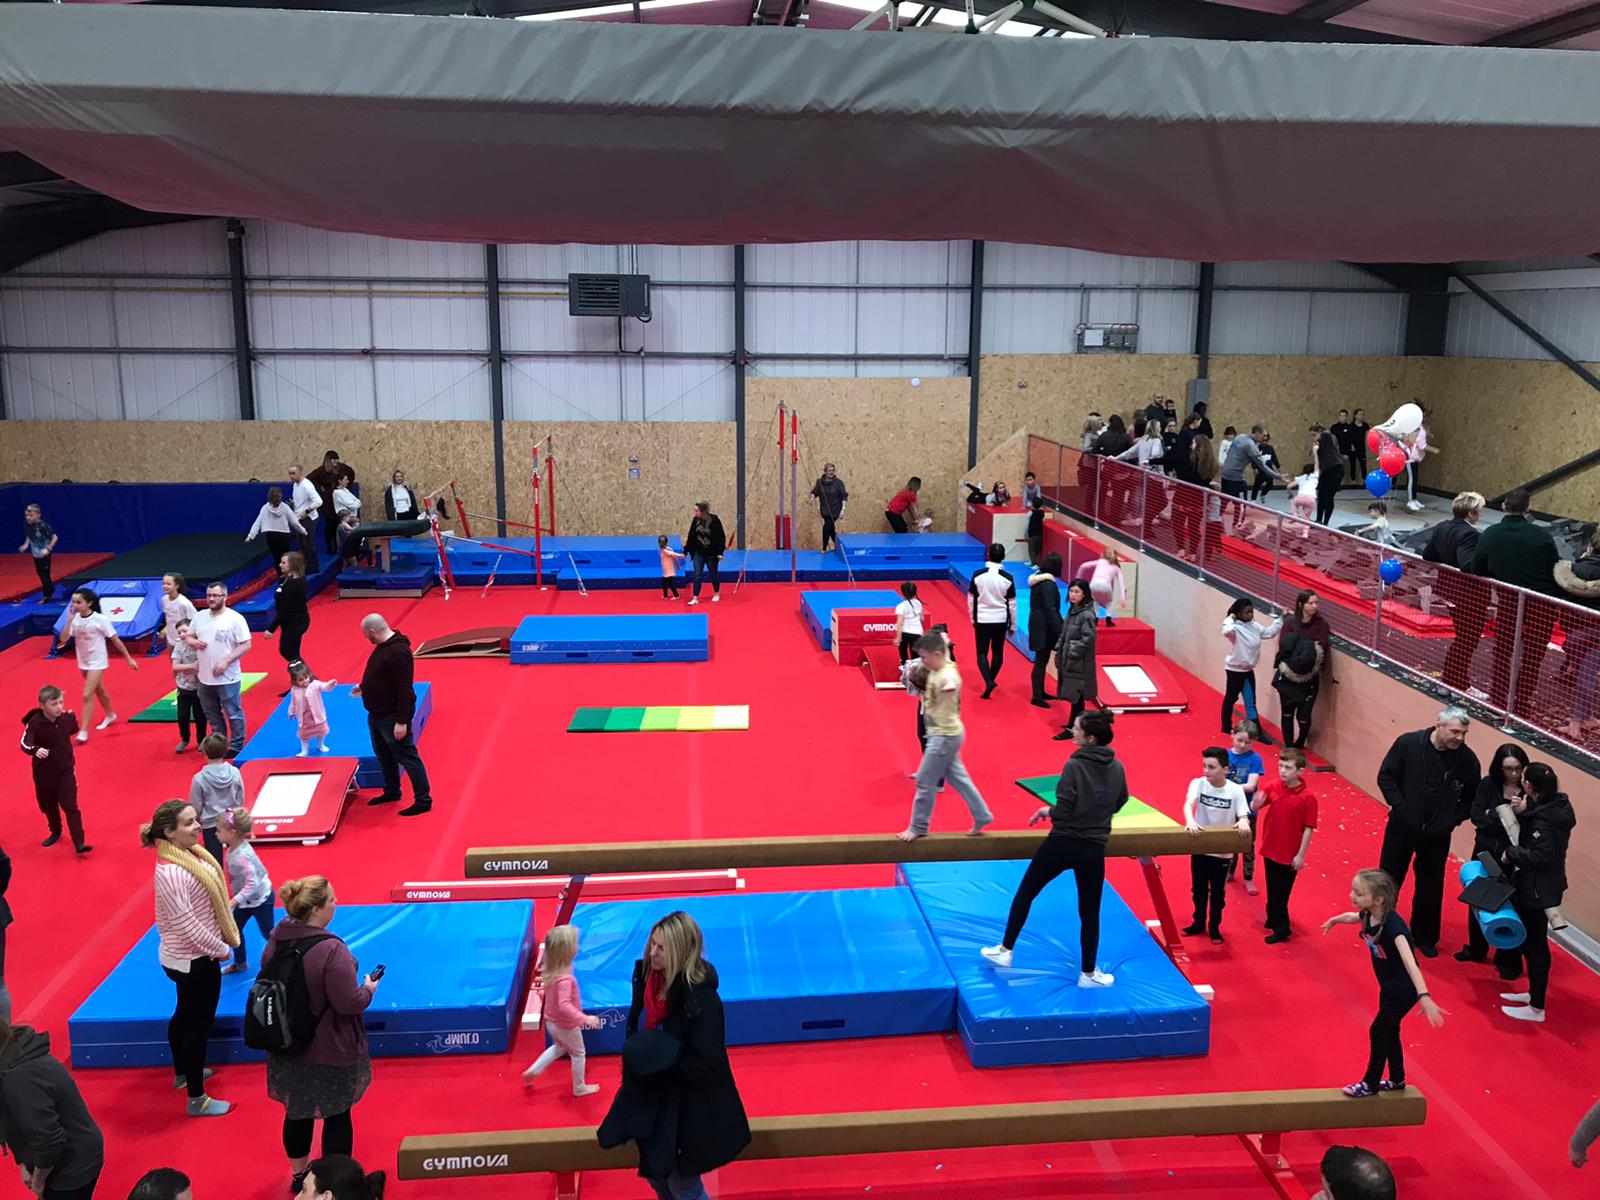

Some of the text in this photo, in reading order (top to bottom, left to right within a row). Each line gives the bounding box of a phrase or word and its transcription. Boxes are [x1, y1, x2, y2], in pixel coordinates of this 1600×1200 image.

[863, 623, 898, 632] GYMNO
[483, 859, 549, 871] GYMNOVA
[406, 890, 451, 899] GYMNOVA
[422, 1153, 509, 1171] GYMNOVA
